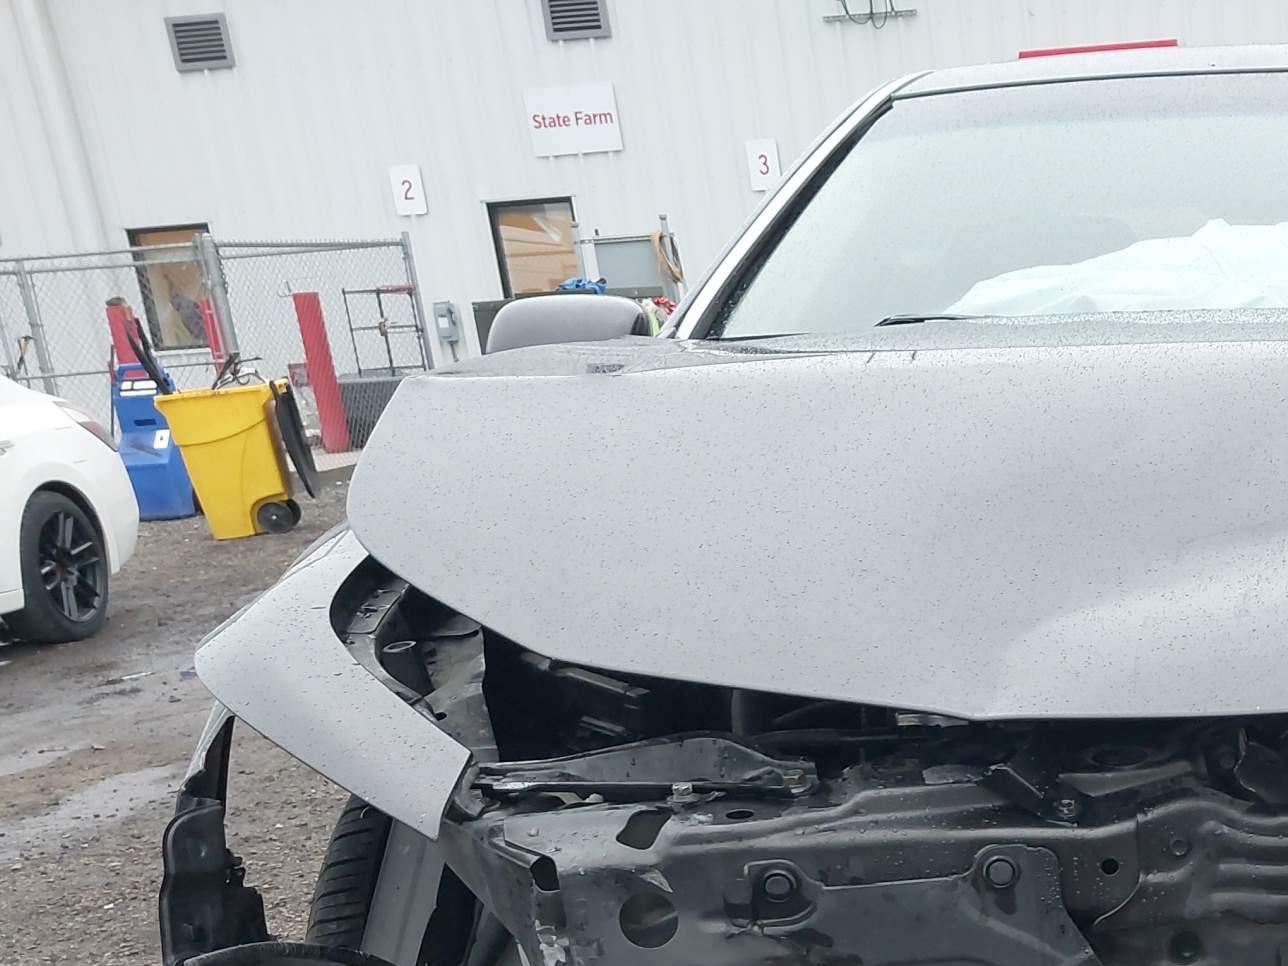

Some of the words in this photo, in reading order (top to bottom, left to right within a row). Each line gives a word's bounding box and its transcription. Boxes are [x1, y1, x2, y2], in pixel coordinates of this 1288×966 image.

[532, 113, 571, 129] State
[574, 111, 614, 127] Farm
[758, 153, 770, 176] 3
[401, 179, 415, 201] 2
